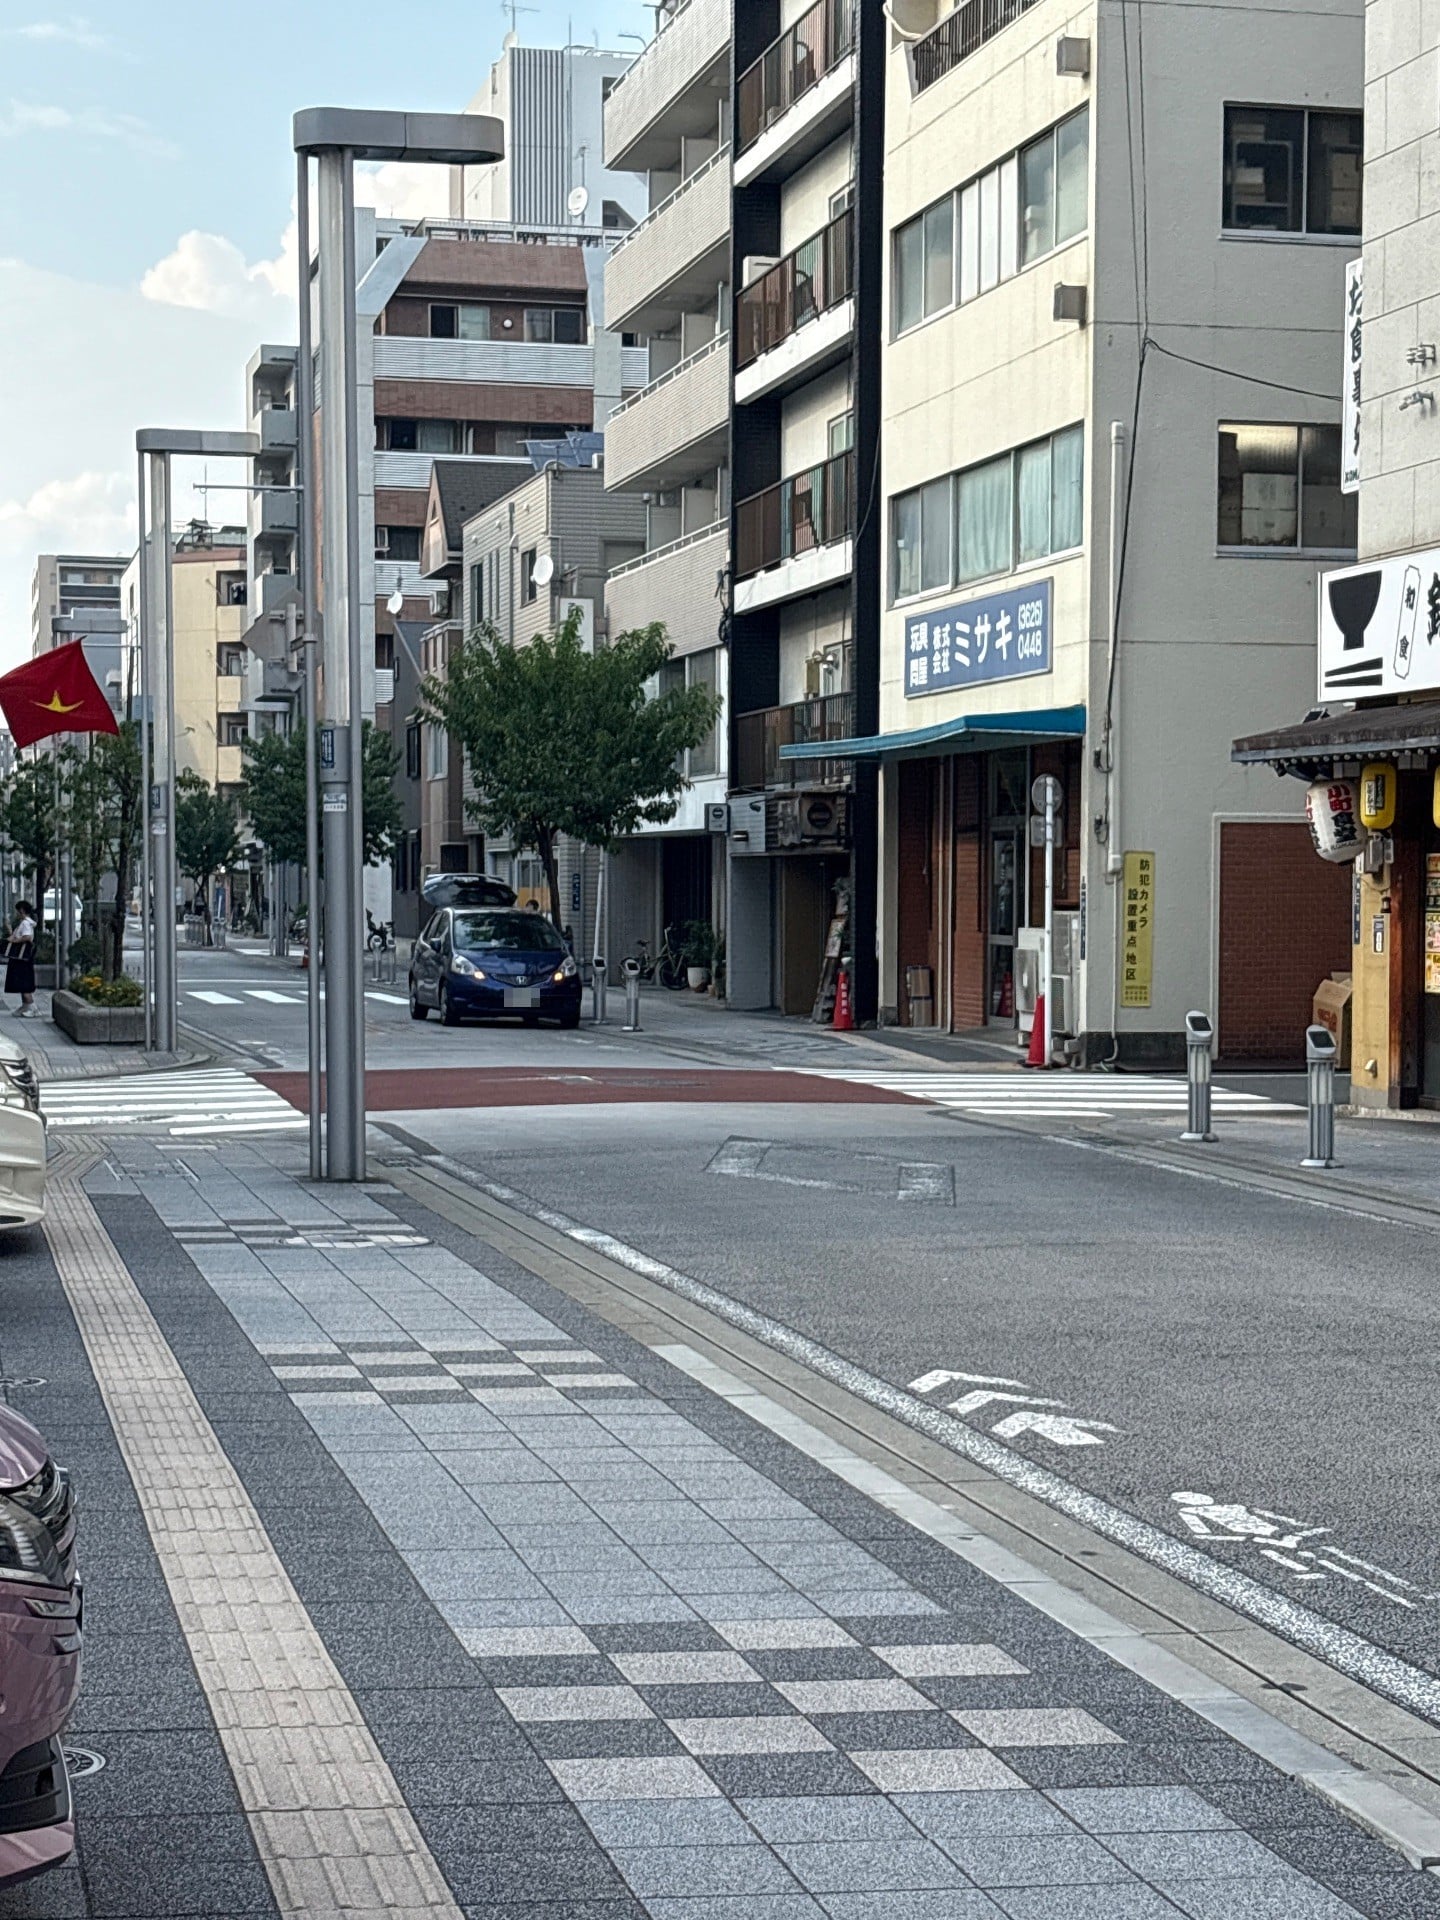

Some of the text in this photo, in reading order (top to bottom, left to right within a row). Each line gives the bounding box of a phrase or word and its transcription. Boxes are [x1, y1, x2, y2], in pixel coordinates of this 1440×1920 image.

[1018, 600, 1043, 630] (3626)
[910, 621, 928, 652] 玩具
[954, 609, 1013, 667] ミサキ
[1017, 630, 1043, 660] 0448
[910, 656, 928, 688] 問屋
[1139, 858, 1150, 928] 防犯カメラ
[1125, 888, 1139, 981] 設置重点地区
